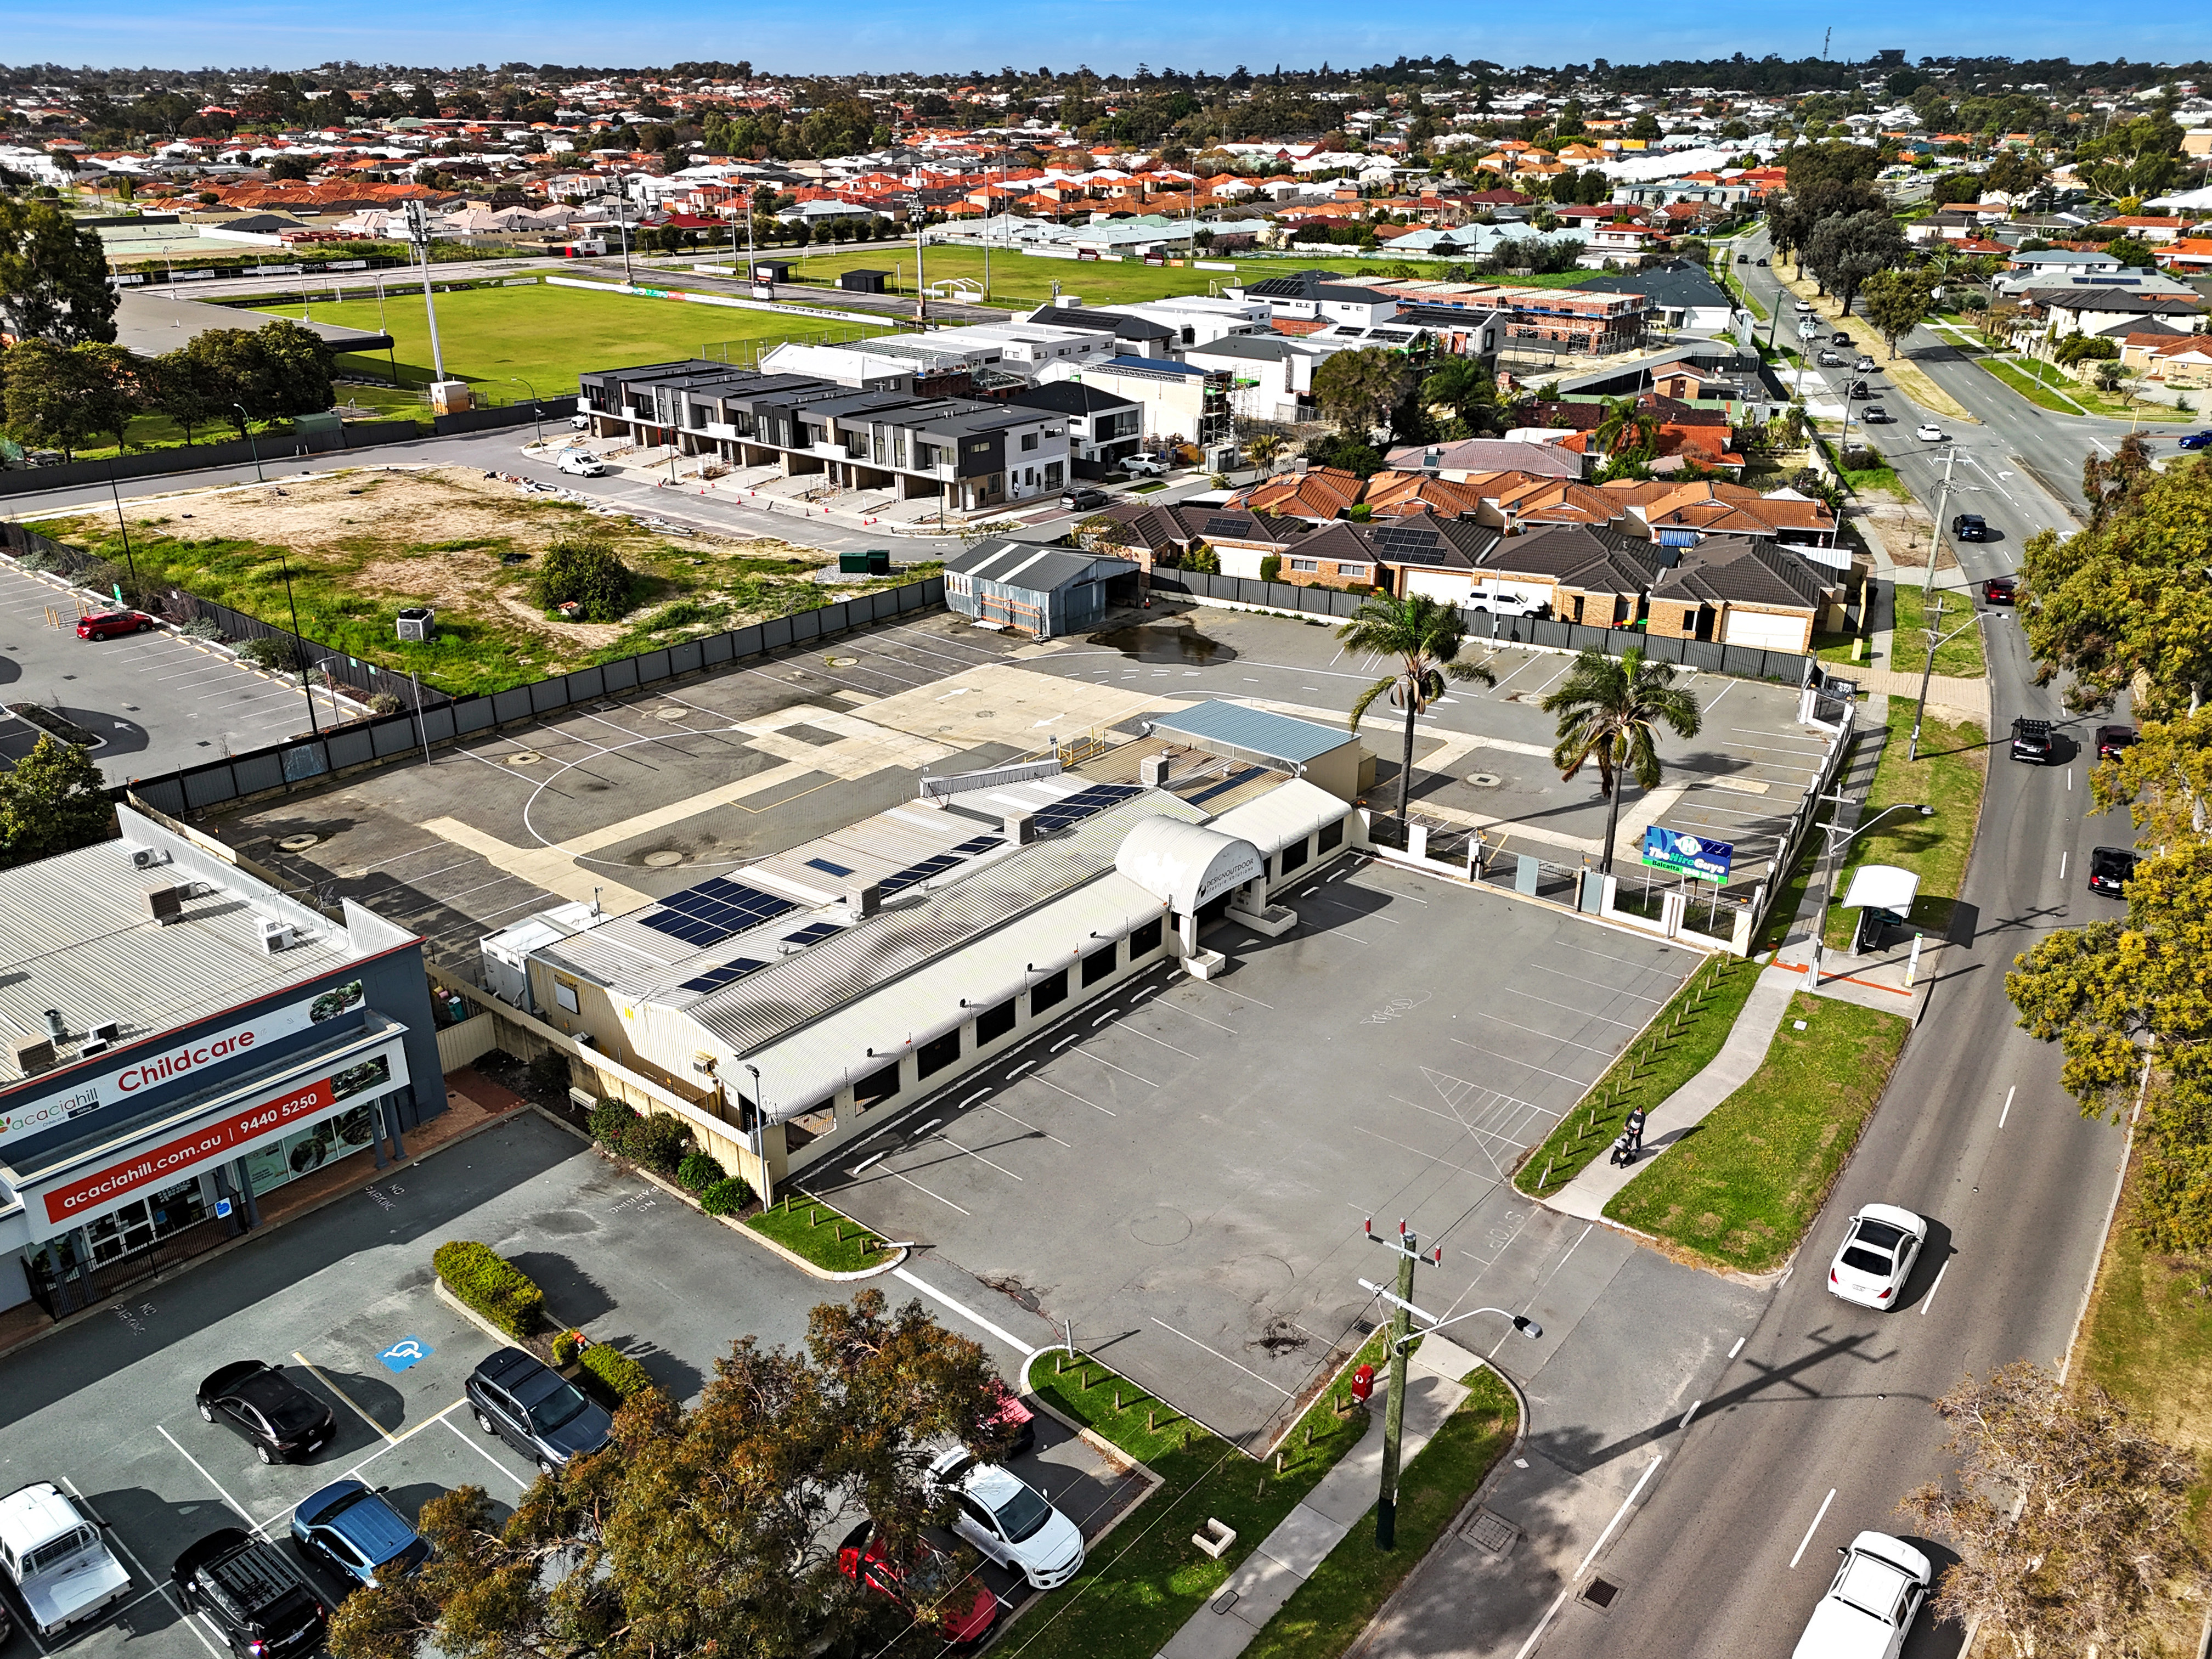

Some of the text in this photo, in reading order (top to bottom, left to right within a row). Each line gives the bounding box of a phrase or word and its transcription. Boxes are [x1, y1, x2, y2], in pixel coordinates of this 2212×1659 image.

[1207, 858, 1254, 888] DESIGNOUTDOOR
[1229, 867, 1254, 881] solutions
[1649, 847, 1725, 873] TheHireGuys
[1652, 860, 1679, 871] Balcatta
[118, 1031, 255, 1092] Childcare
[12, 1087, 98, 1130] acaciahill
[64, 1135, 222, 1208] acaciahill.com.au
[240, 1110, 278, 1133] 9440
[282, 1093, 317, 1116] 5250
